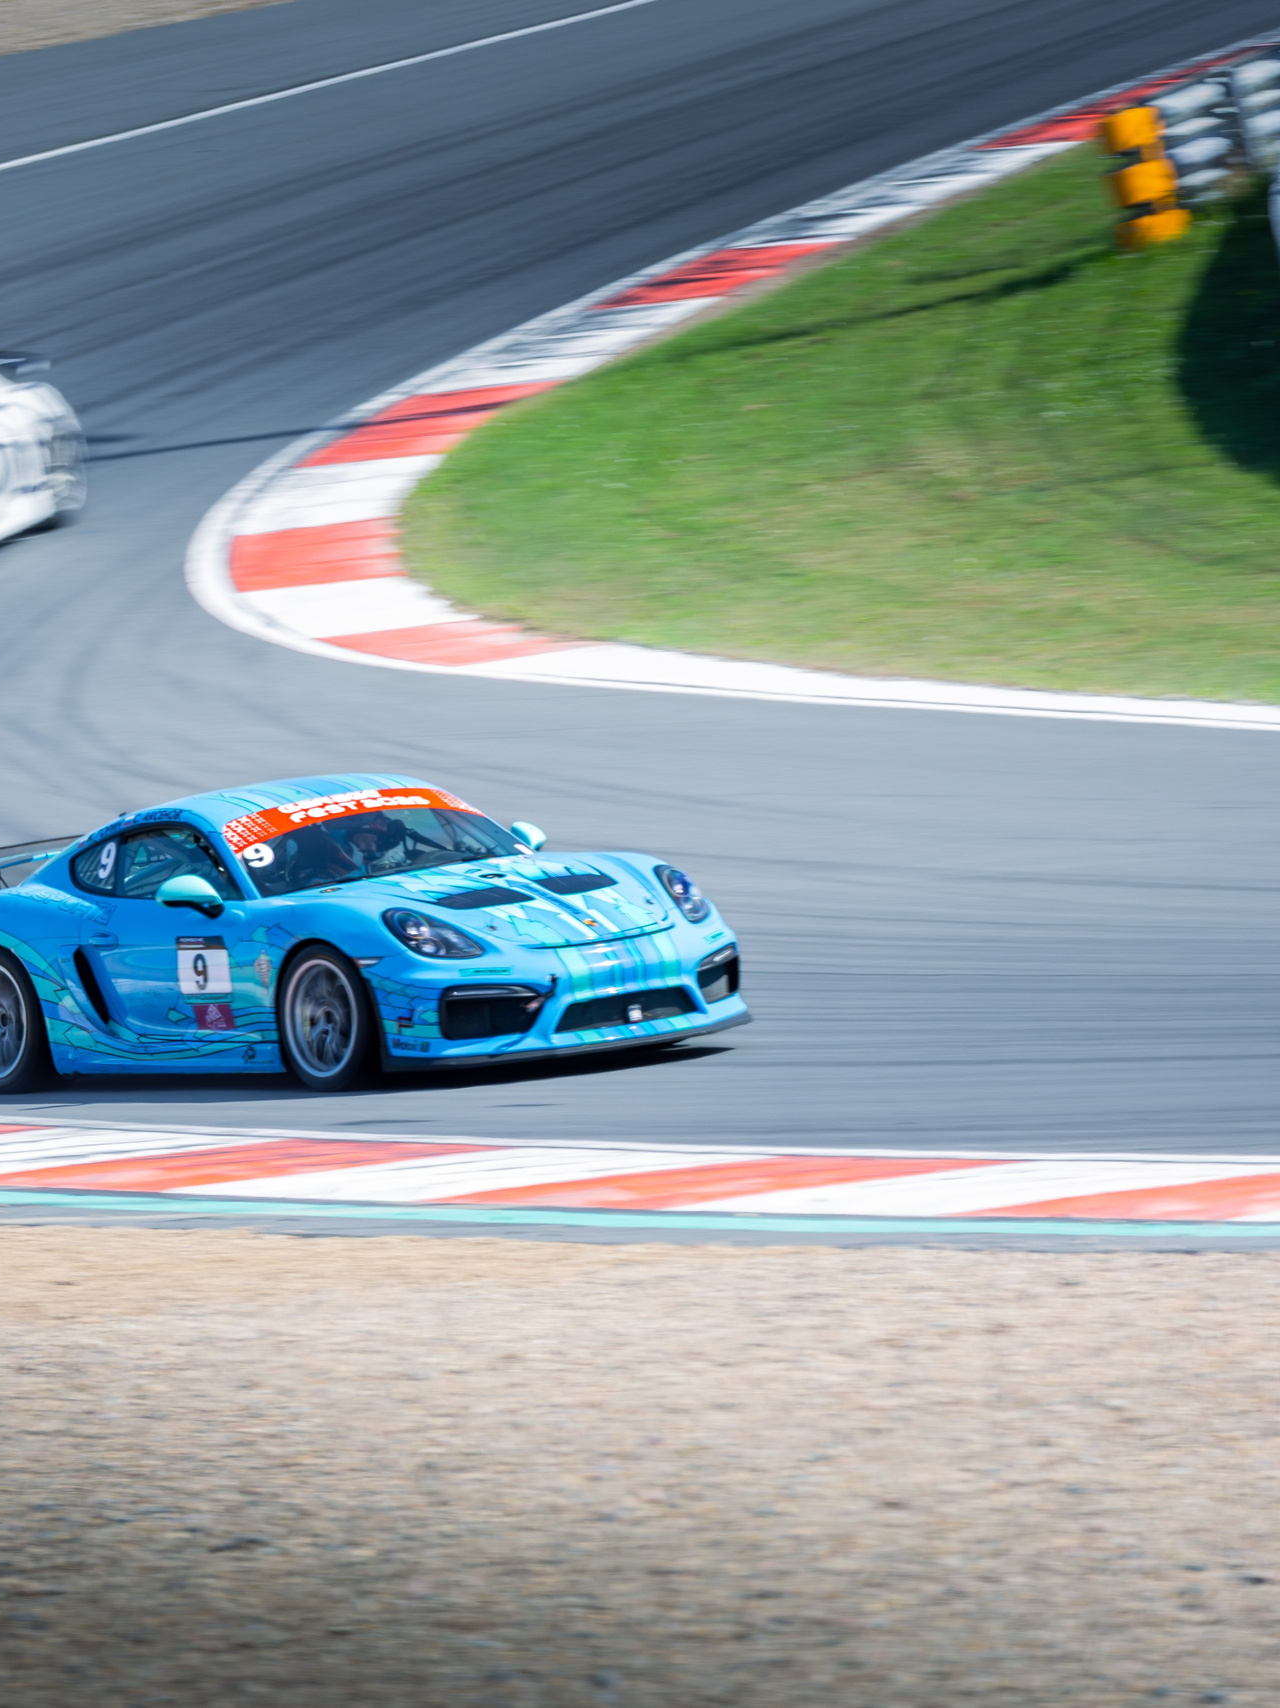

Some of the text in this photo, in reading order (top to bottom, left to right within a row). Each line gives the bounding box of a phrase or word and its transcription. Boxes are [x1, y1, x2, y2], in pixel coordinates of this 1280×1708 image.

[98, 841, 117, 879] 9
[242, 842, 275, 869] 9
[192, 953, 209, 991] 9
